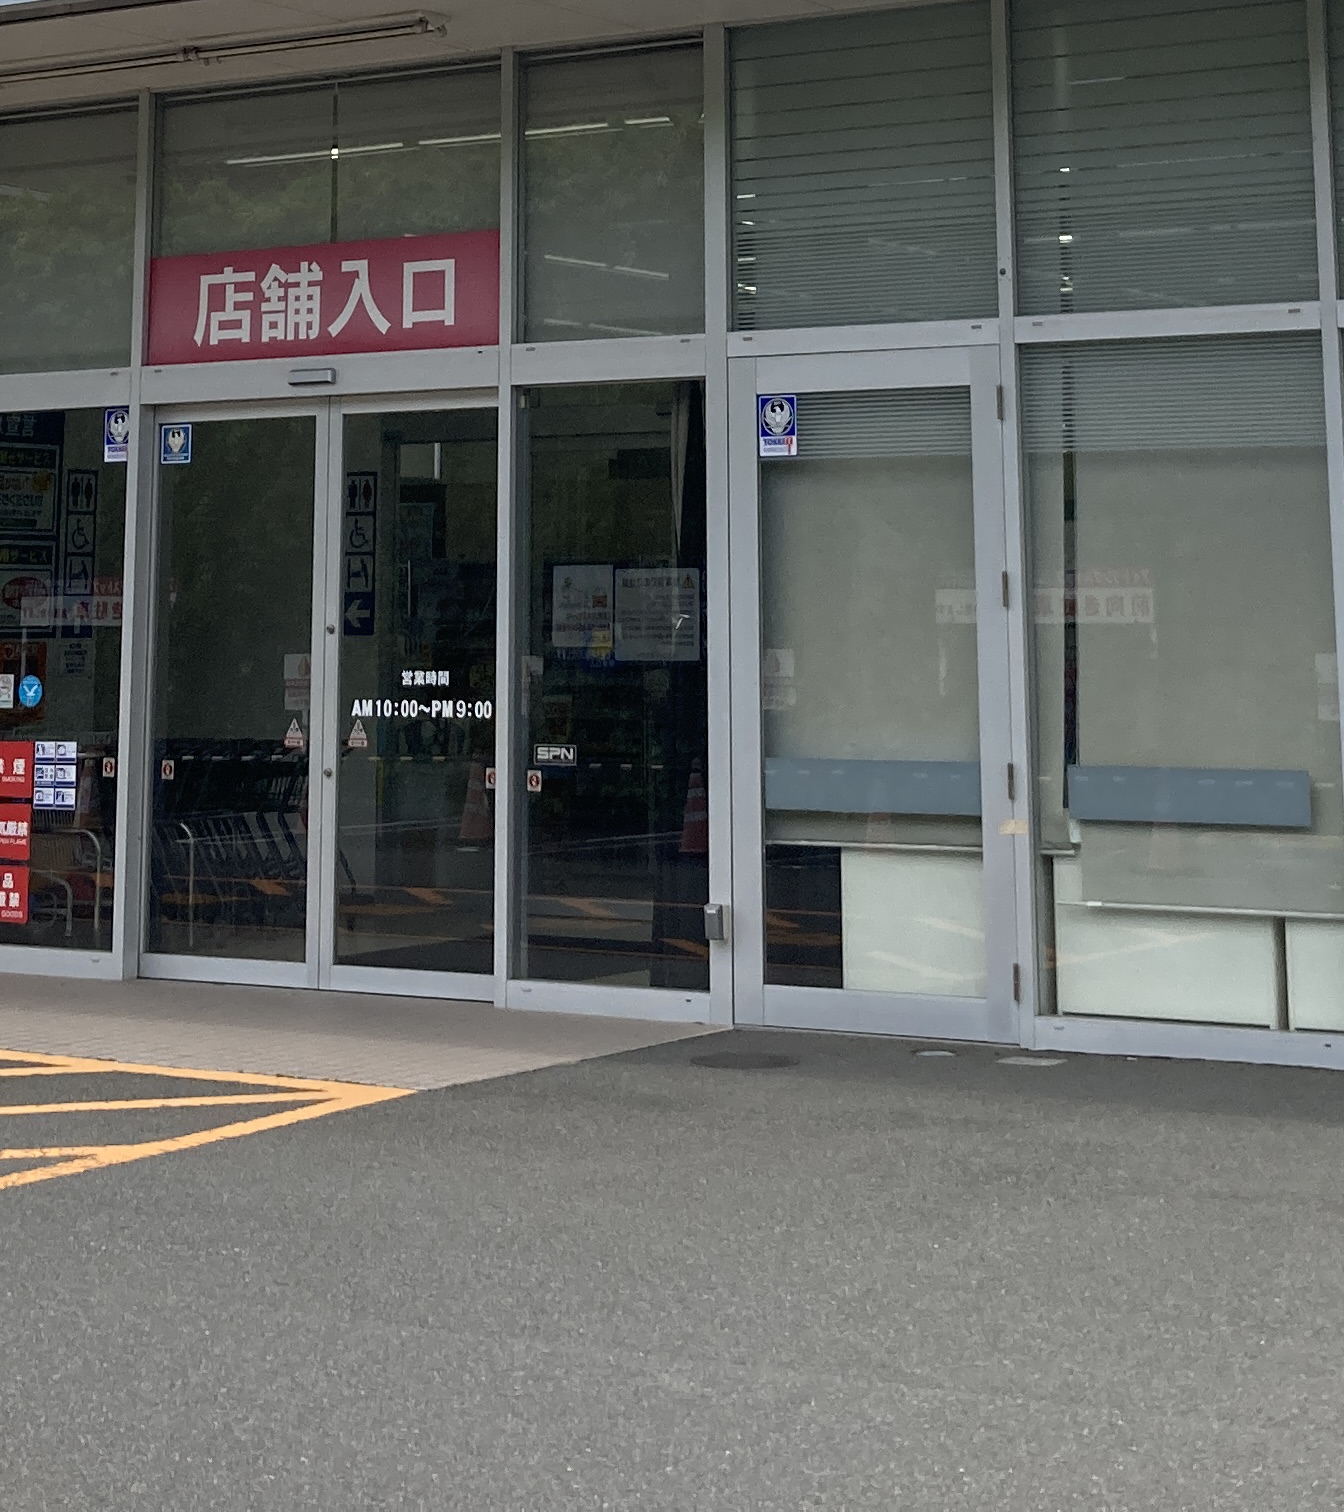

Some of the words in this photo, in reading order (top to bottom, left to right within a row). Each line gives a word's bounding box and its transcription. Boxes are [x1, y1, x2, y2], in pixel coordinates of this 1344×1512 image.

[193, 258, 456, 347] 店舗入口
[401, 669, 450, 687] 営業時間
[536, 747, 574, 761] SPN
